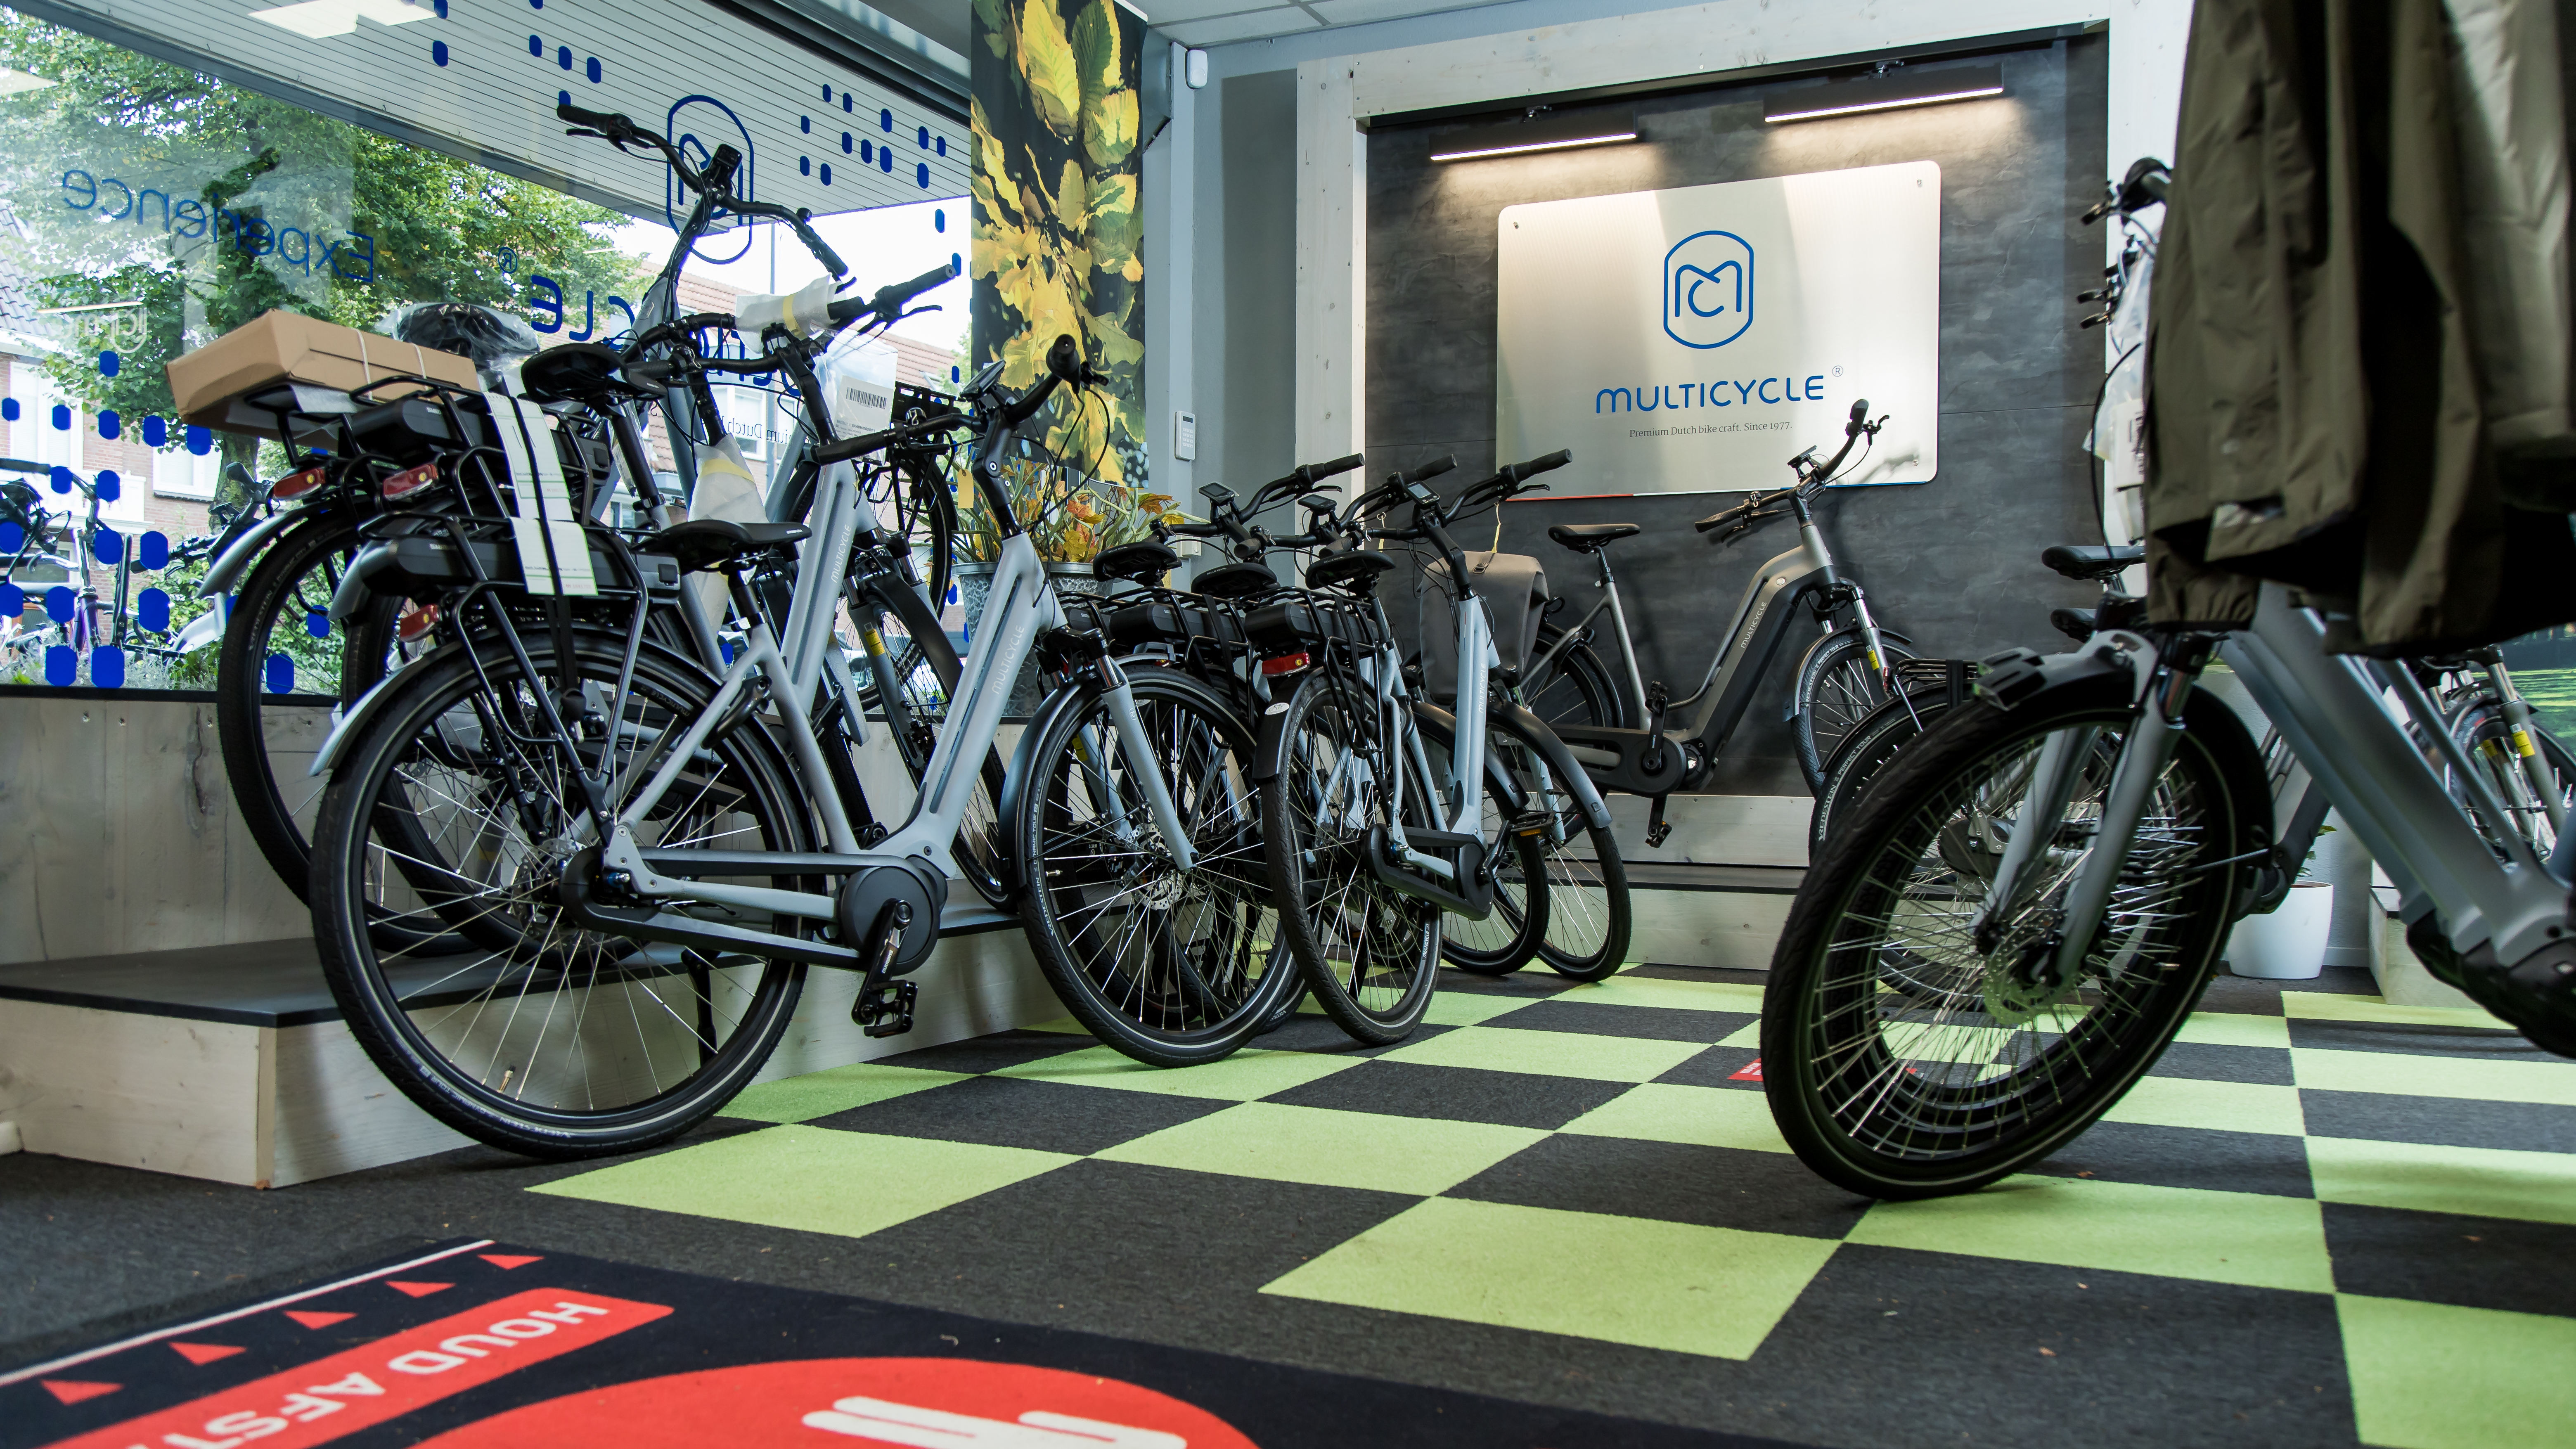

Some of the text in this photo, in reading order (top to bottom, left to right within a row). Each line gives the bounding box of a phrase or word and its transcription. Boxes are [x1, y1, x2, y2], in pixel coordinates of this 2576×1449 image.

[1596, 375, 1824, 414] MULTICYCLE
[1629, 421, 1792, 437] Premium Dutch bike craft. Since 1977.
[831, 524, 851, 583] MULTICYCLE
[1740, 601, 1767, 649] MULTICYCLE
[991, 625, 1025, 695] MULTICYCLE
[1818, 650, 1830, 666] PERFECT
[1830, 644, 1840, 653] TOUR
[1478, 662, 1487, 714] MULTICYCLE
[1818, 735, 1872, 841] VREDESTEIN PERFECT TOUR
[388, 1301, 610, 1374] HOUD
[126, 1372, 385, 1449] AFST
